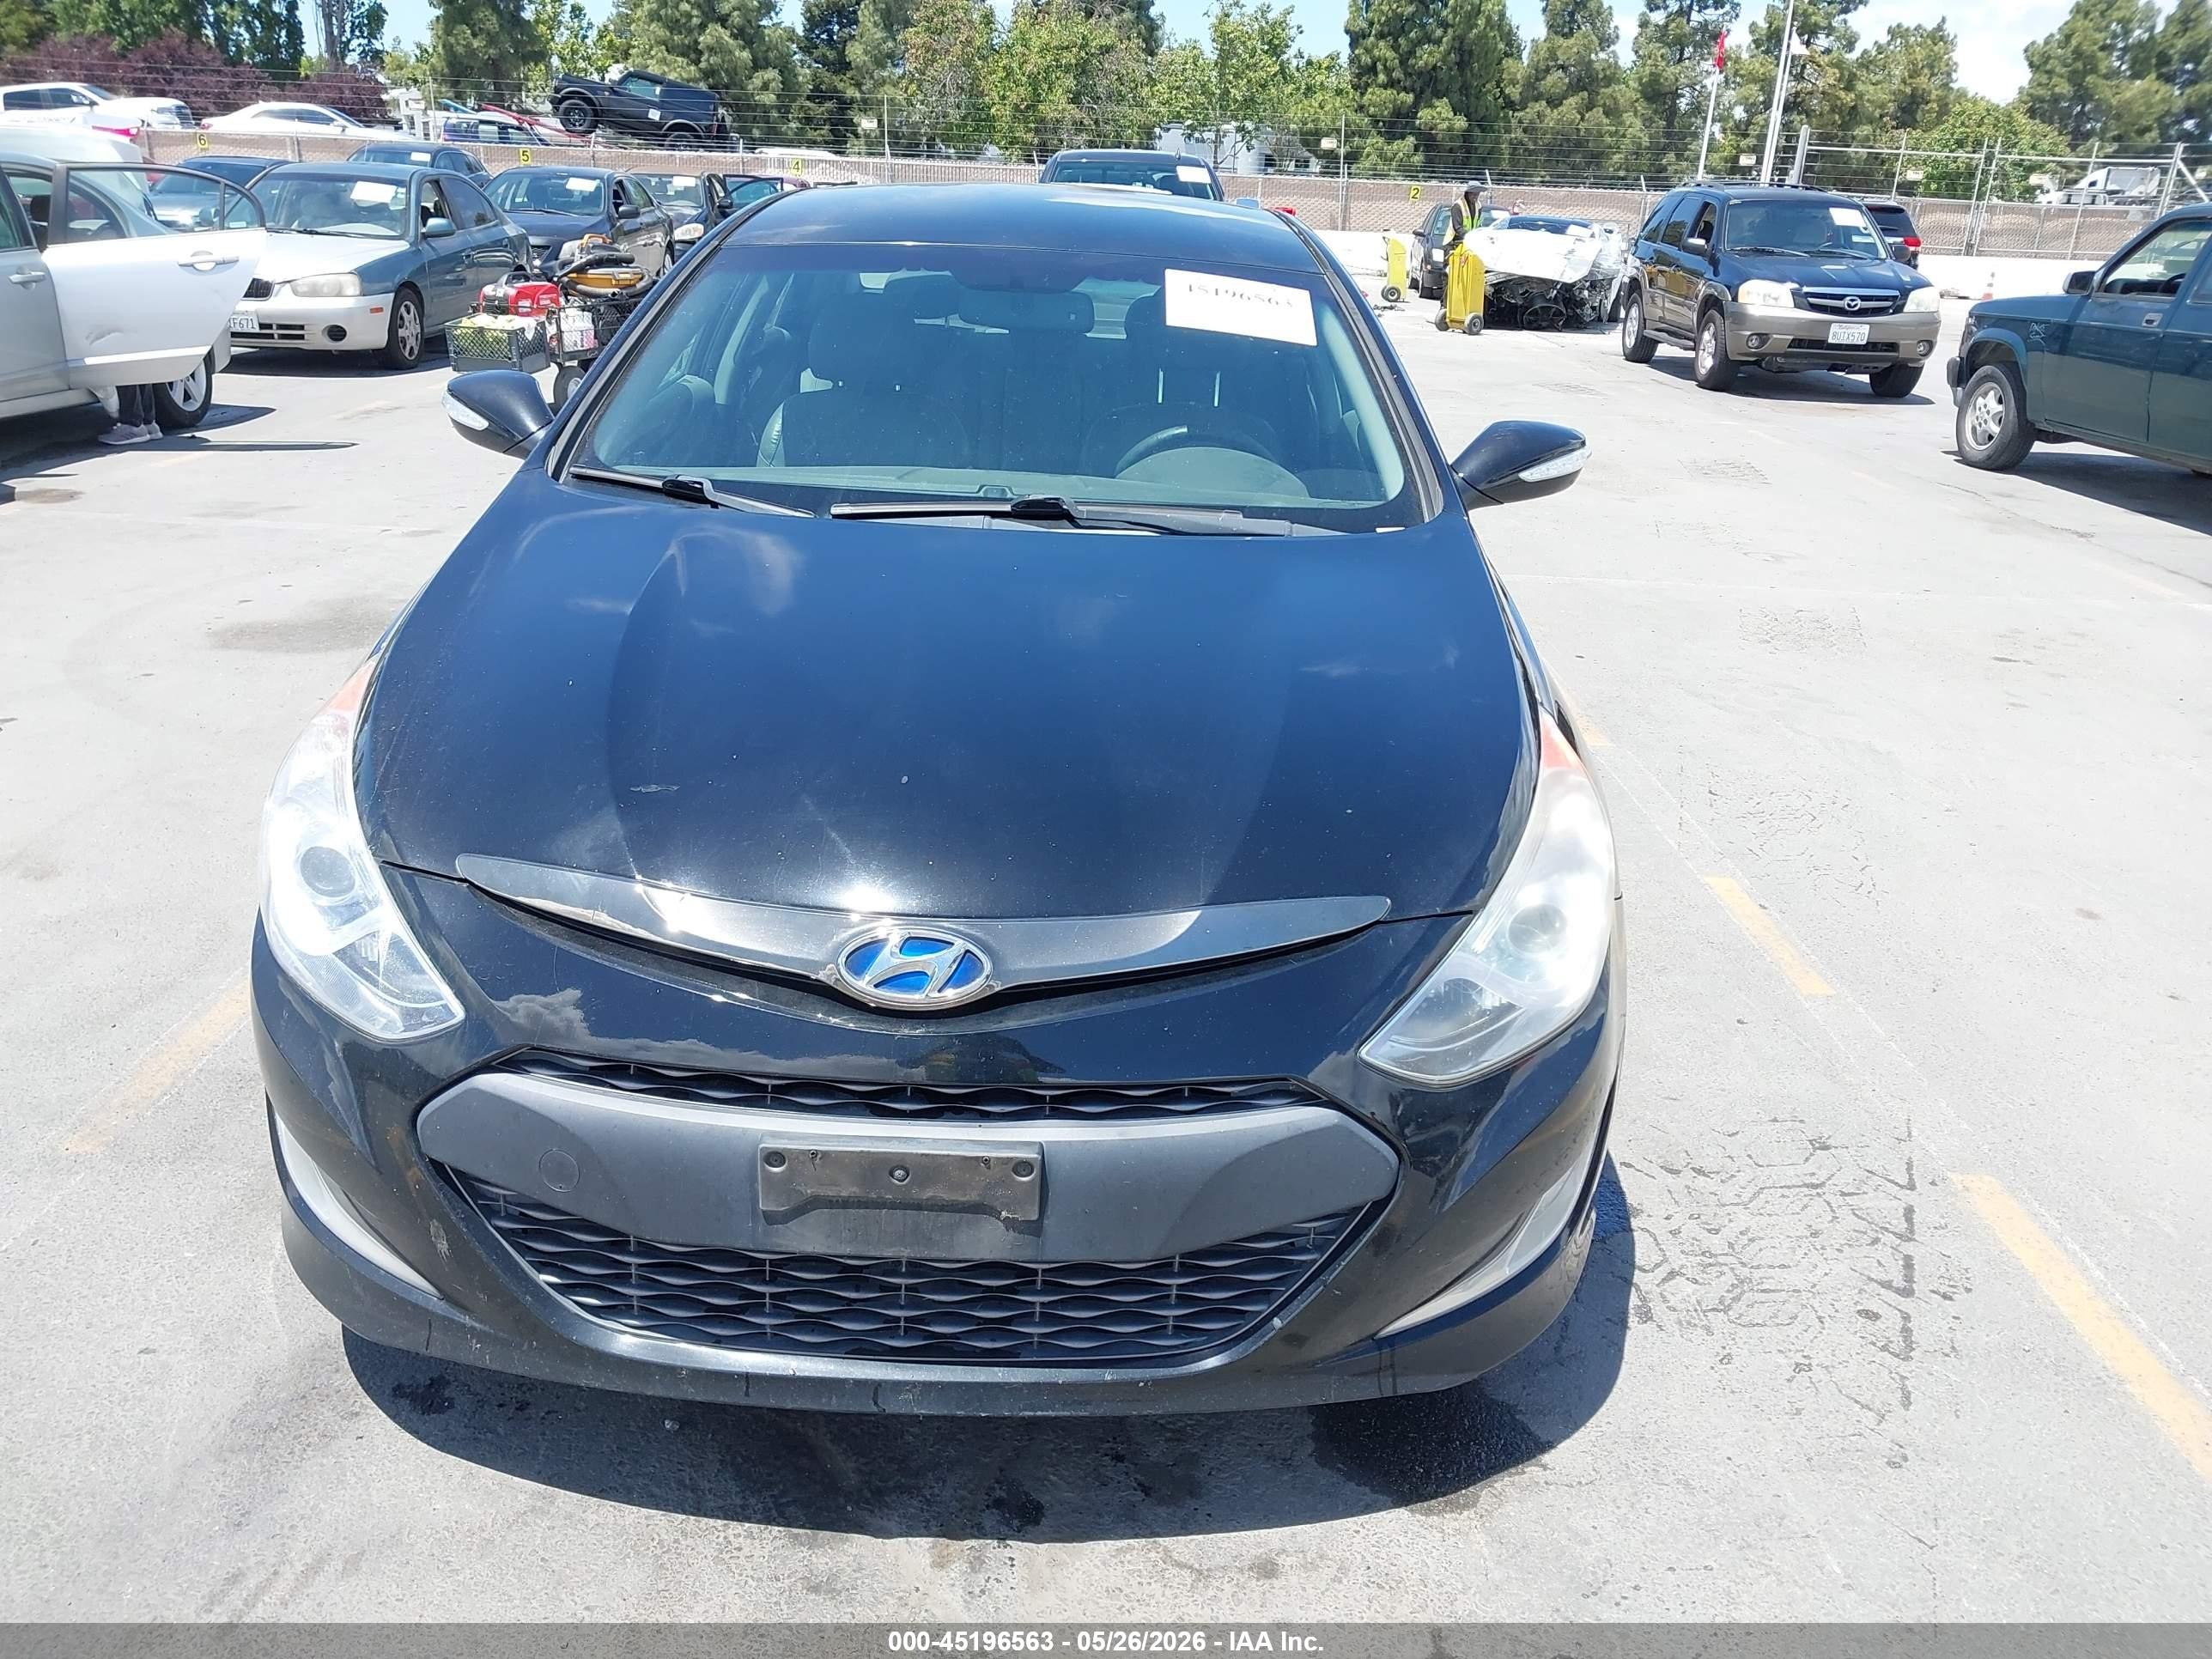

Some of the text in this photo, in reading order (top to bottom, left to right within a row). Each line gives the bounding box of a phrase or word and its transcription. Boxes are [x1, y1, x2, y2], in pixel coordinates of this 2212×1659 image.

[198, 133, 207, 146] 6
[521, 149, 530, 162] 5
[792, 160, 800, 173] 4
[1411, 186, 1420, 199] 2
